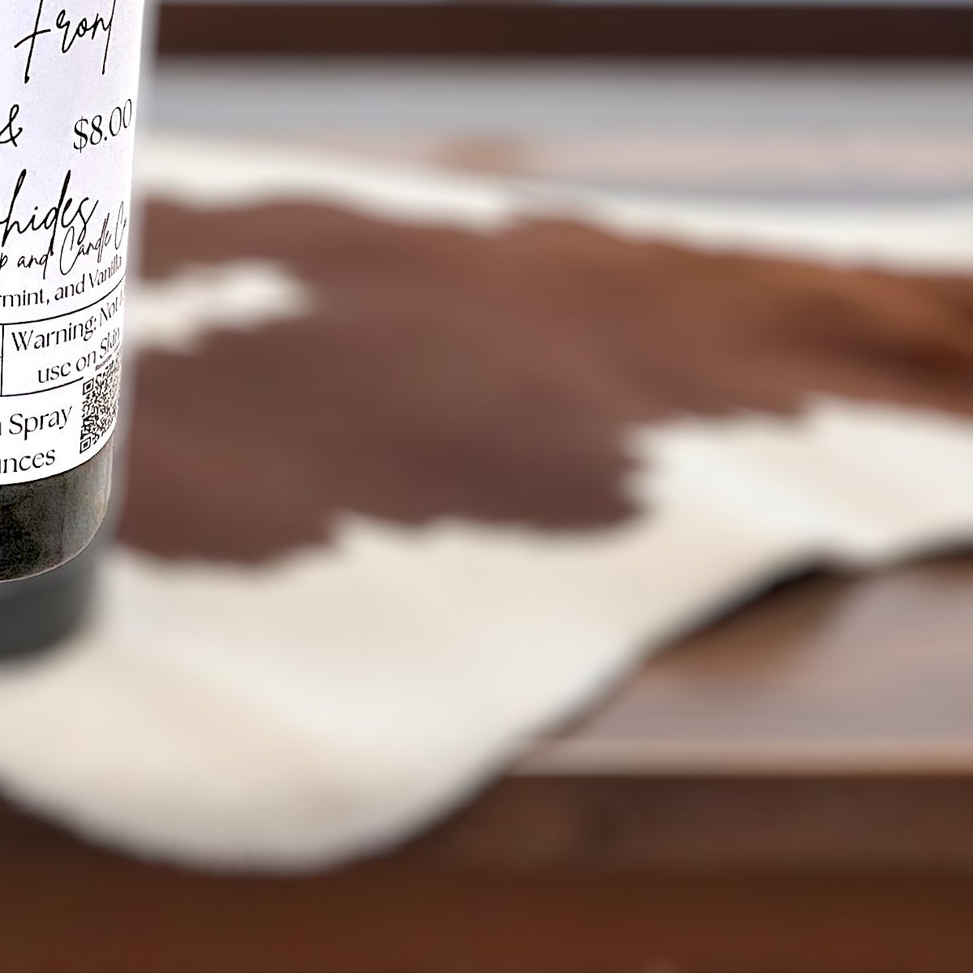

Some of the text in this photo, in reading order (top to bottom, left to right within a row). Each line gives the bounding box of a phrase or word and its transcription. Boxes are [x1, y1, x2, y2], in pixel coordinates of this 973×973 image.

[73, 98, 133, 153] $8.00
[17, 249, 54, 279] and
[54, 273, 86, 302] and
[11, 315, 97, 353] Warning:
[37, 361, 72, 384] use
[75, 350, 97, 372] on
[8, 405, 73, 440] Spray
